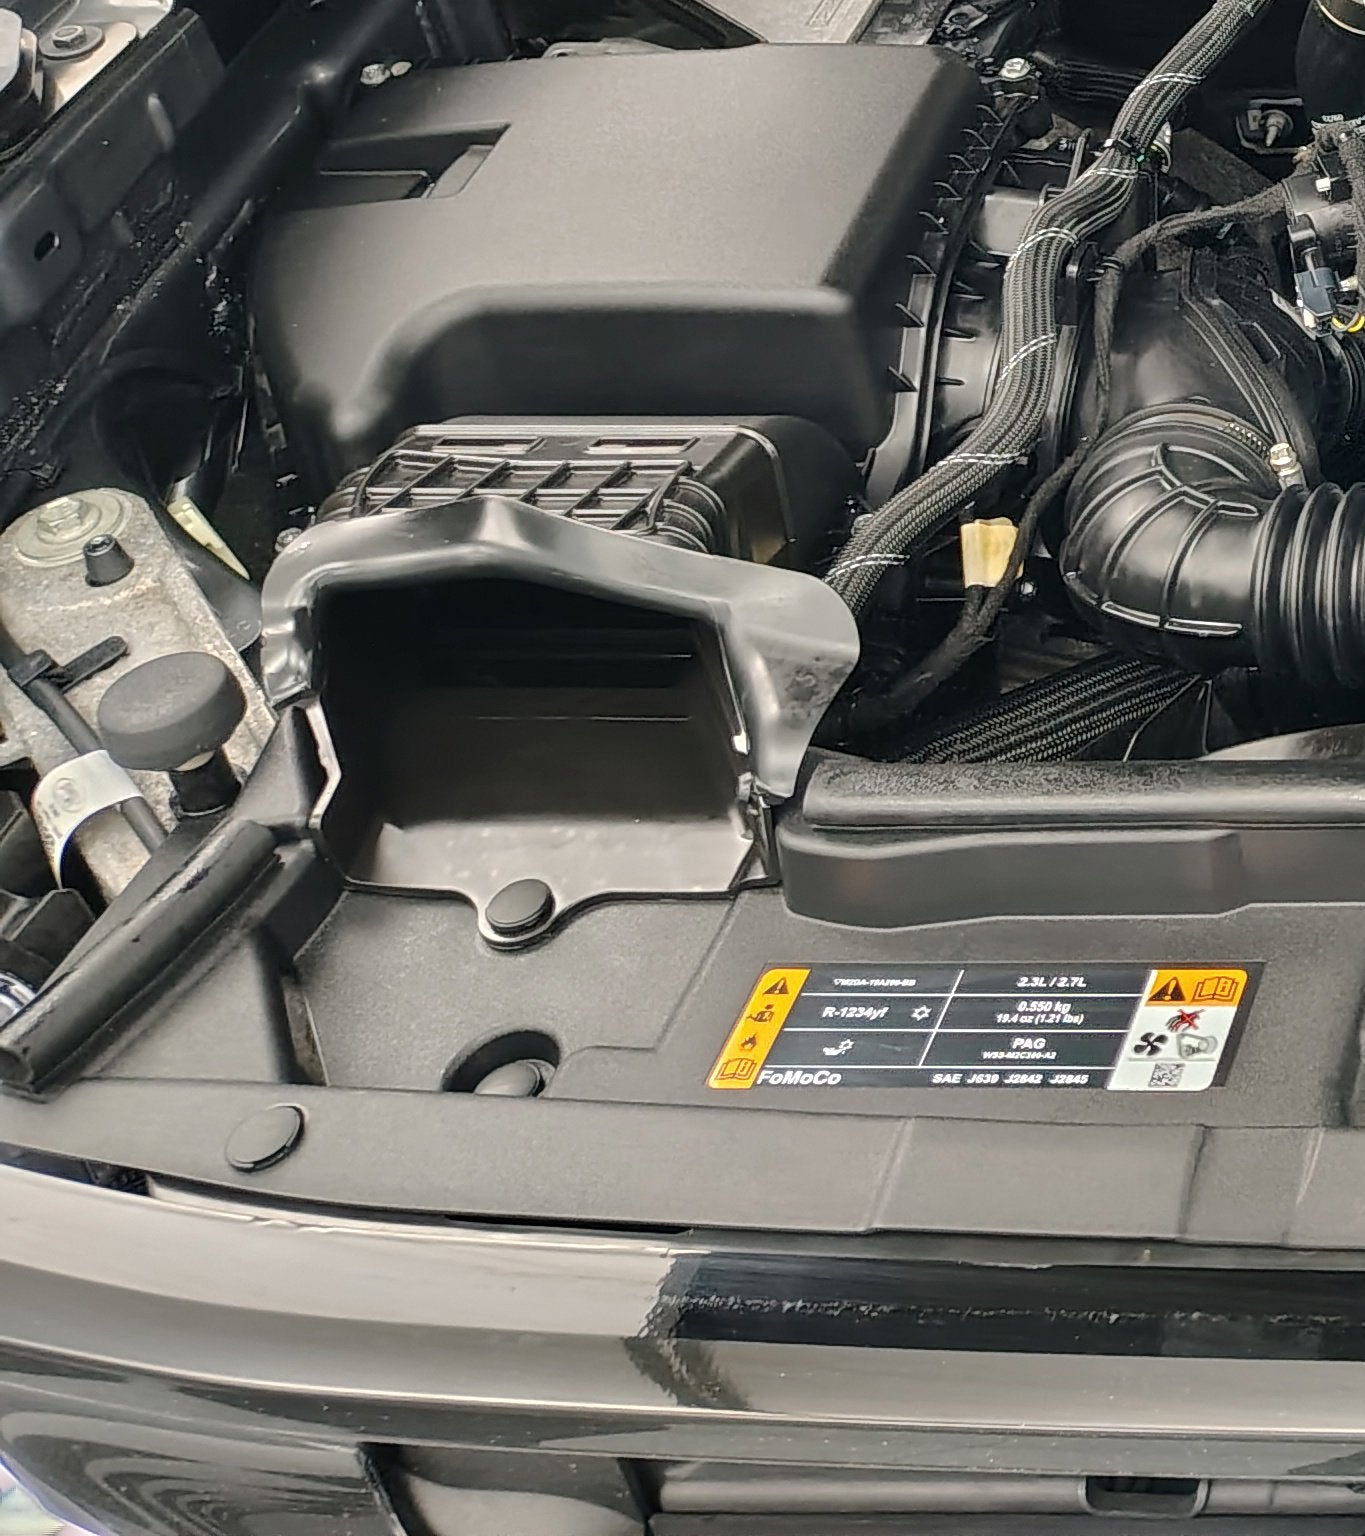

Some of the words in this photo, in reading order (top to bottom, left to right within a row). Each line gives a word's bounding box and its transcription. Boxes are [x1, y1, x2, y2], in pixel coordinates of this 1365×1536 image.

[1016, 976, 1047, 987] 2.3L
[1057, 976, 1087, 987] 2.7L
[821, 1006, 890, 1020] R-1234yf
[1017, 1000, 1053, 1012] 0.550
[1053, 1001, 1072, 1014] kg
[996, 1013, 1019, 1023] 19.4
[1034, 1014, 1062, 1024] (1.21
[1062, 1014, 1085, 1025] lbs)
[1012, 1037, 1047, 1049] PAG
[757, 1069, 842, 1086] FoMoCo
[932, 1073, 961, 1084] SAE
[967, 1073, 1000, 1084] J639
[1003, 1073, 1044, 1084] J2842
[1049, 1074, 1090, 1085] J2845
